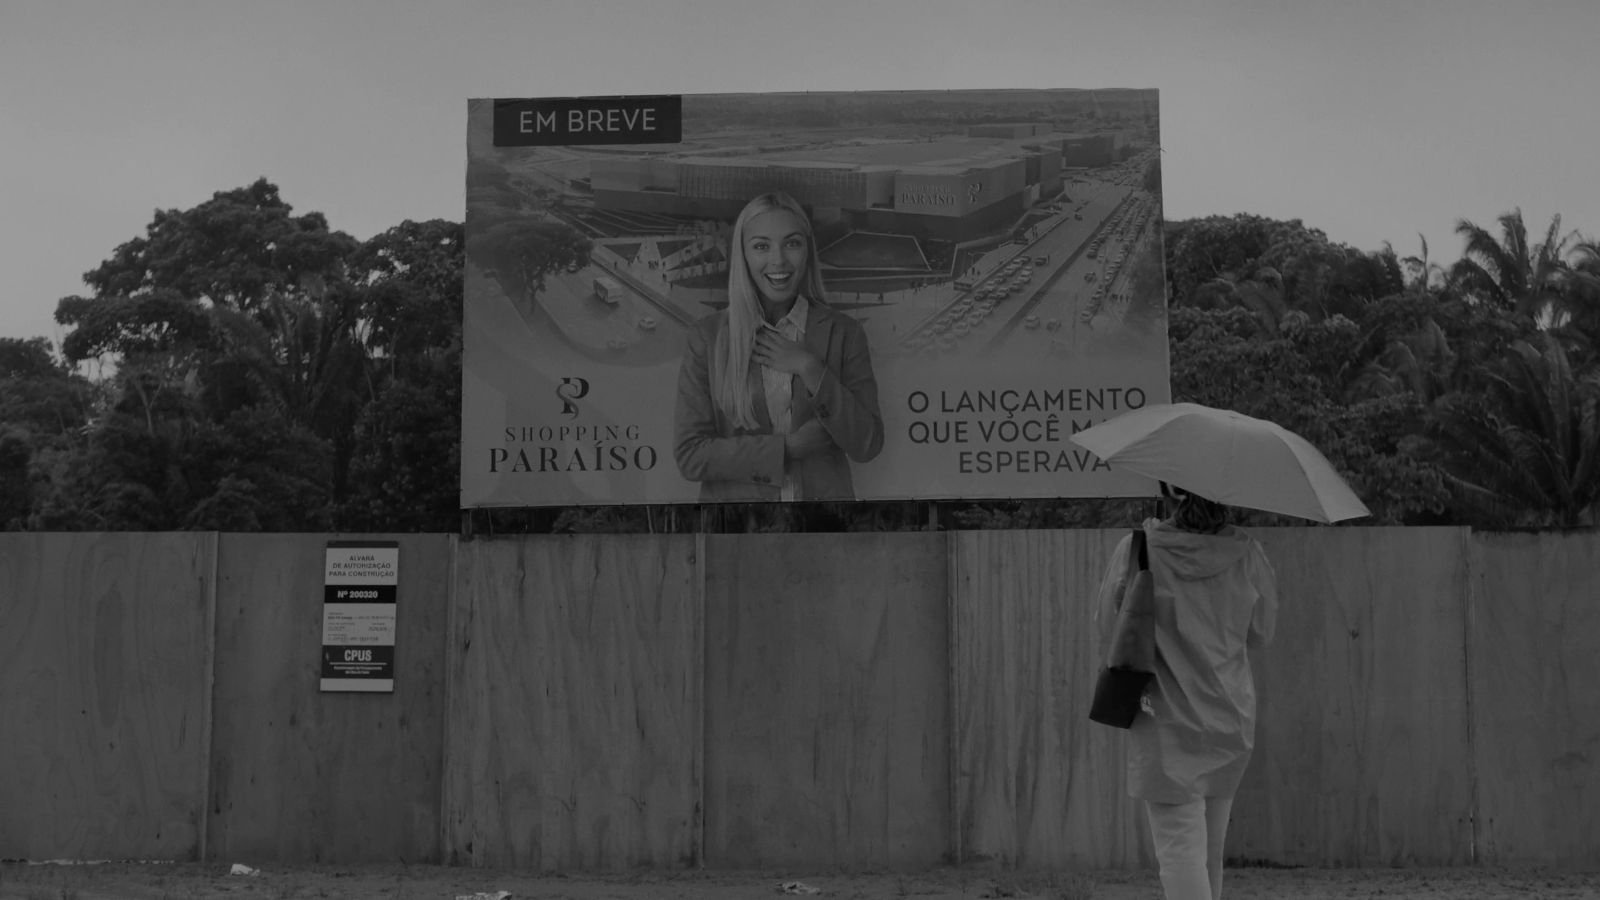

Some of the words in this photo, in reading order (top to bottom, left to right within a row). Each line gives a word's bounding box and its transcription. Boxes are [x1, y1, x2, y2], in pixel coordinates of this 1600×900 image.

[520, 111, 556, 133] EM
[568, 108, 656, 132] BREVE
[908, 391, 929, 413] O
[941, 387, 1147, 419] LANÇAMENTO
[505, 425, 640, 442] SHOPPING
[908, 421, 968, 445] QUE
[978, 414, 1060, 443] VOCÊ
[489, 440, 657, 473] PARAÍSO
[959, 450, 1112, 474] ESPERAVA
[344, 649, 372, 662] CPUS
